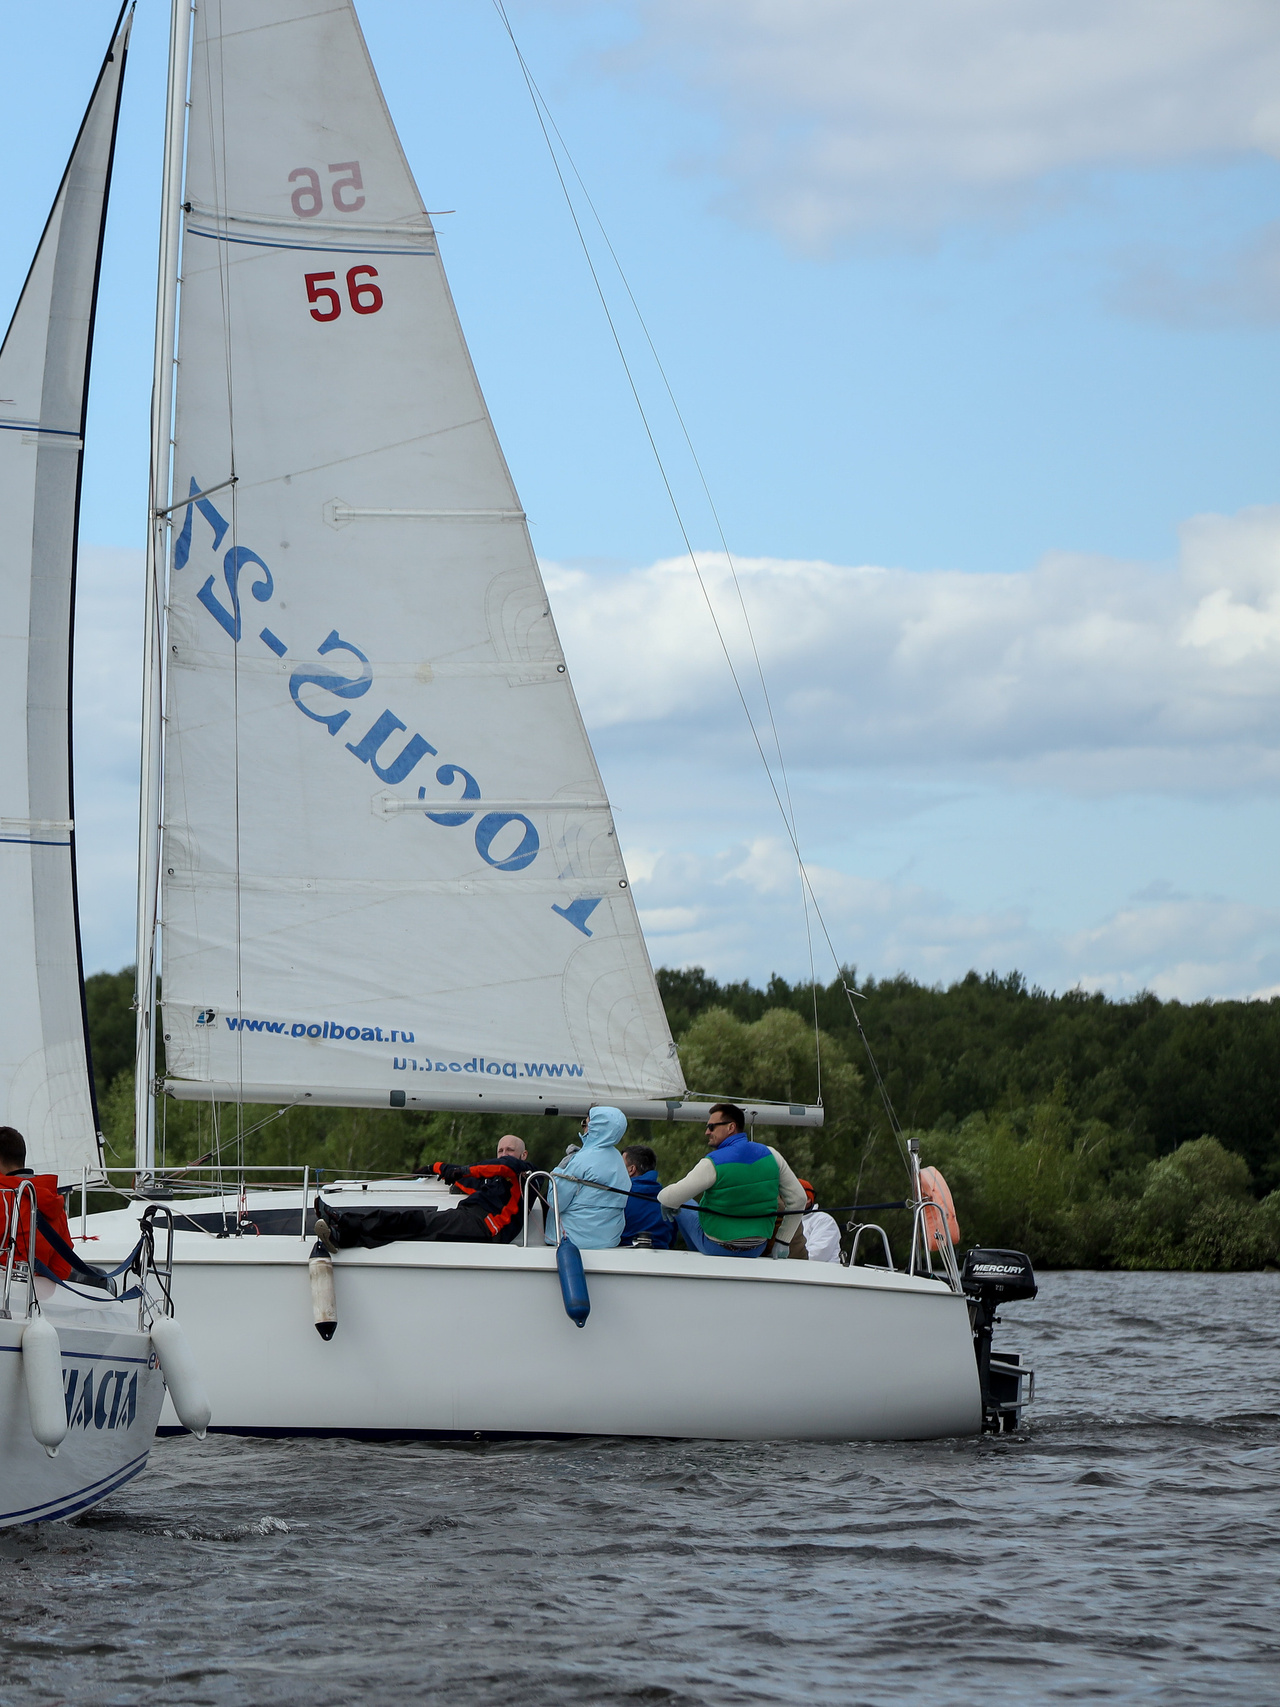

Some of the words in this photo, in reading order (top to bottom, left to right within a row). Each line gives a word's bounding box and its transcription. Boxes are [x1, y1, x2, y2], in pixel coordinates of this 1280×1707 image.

[304, 264, 384, 322] 56
[226, 1017, 415, 1043] www.polboat.ru
[972, 1264, 1025, 1274] MERCURY
[148, 1352, 162, 1370] ev
